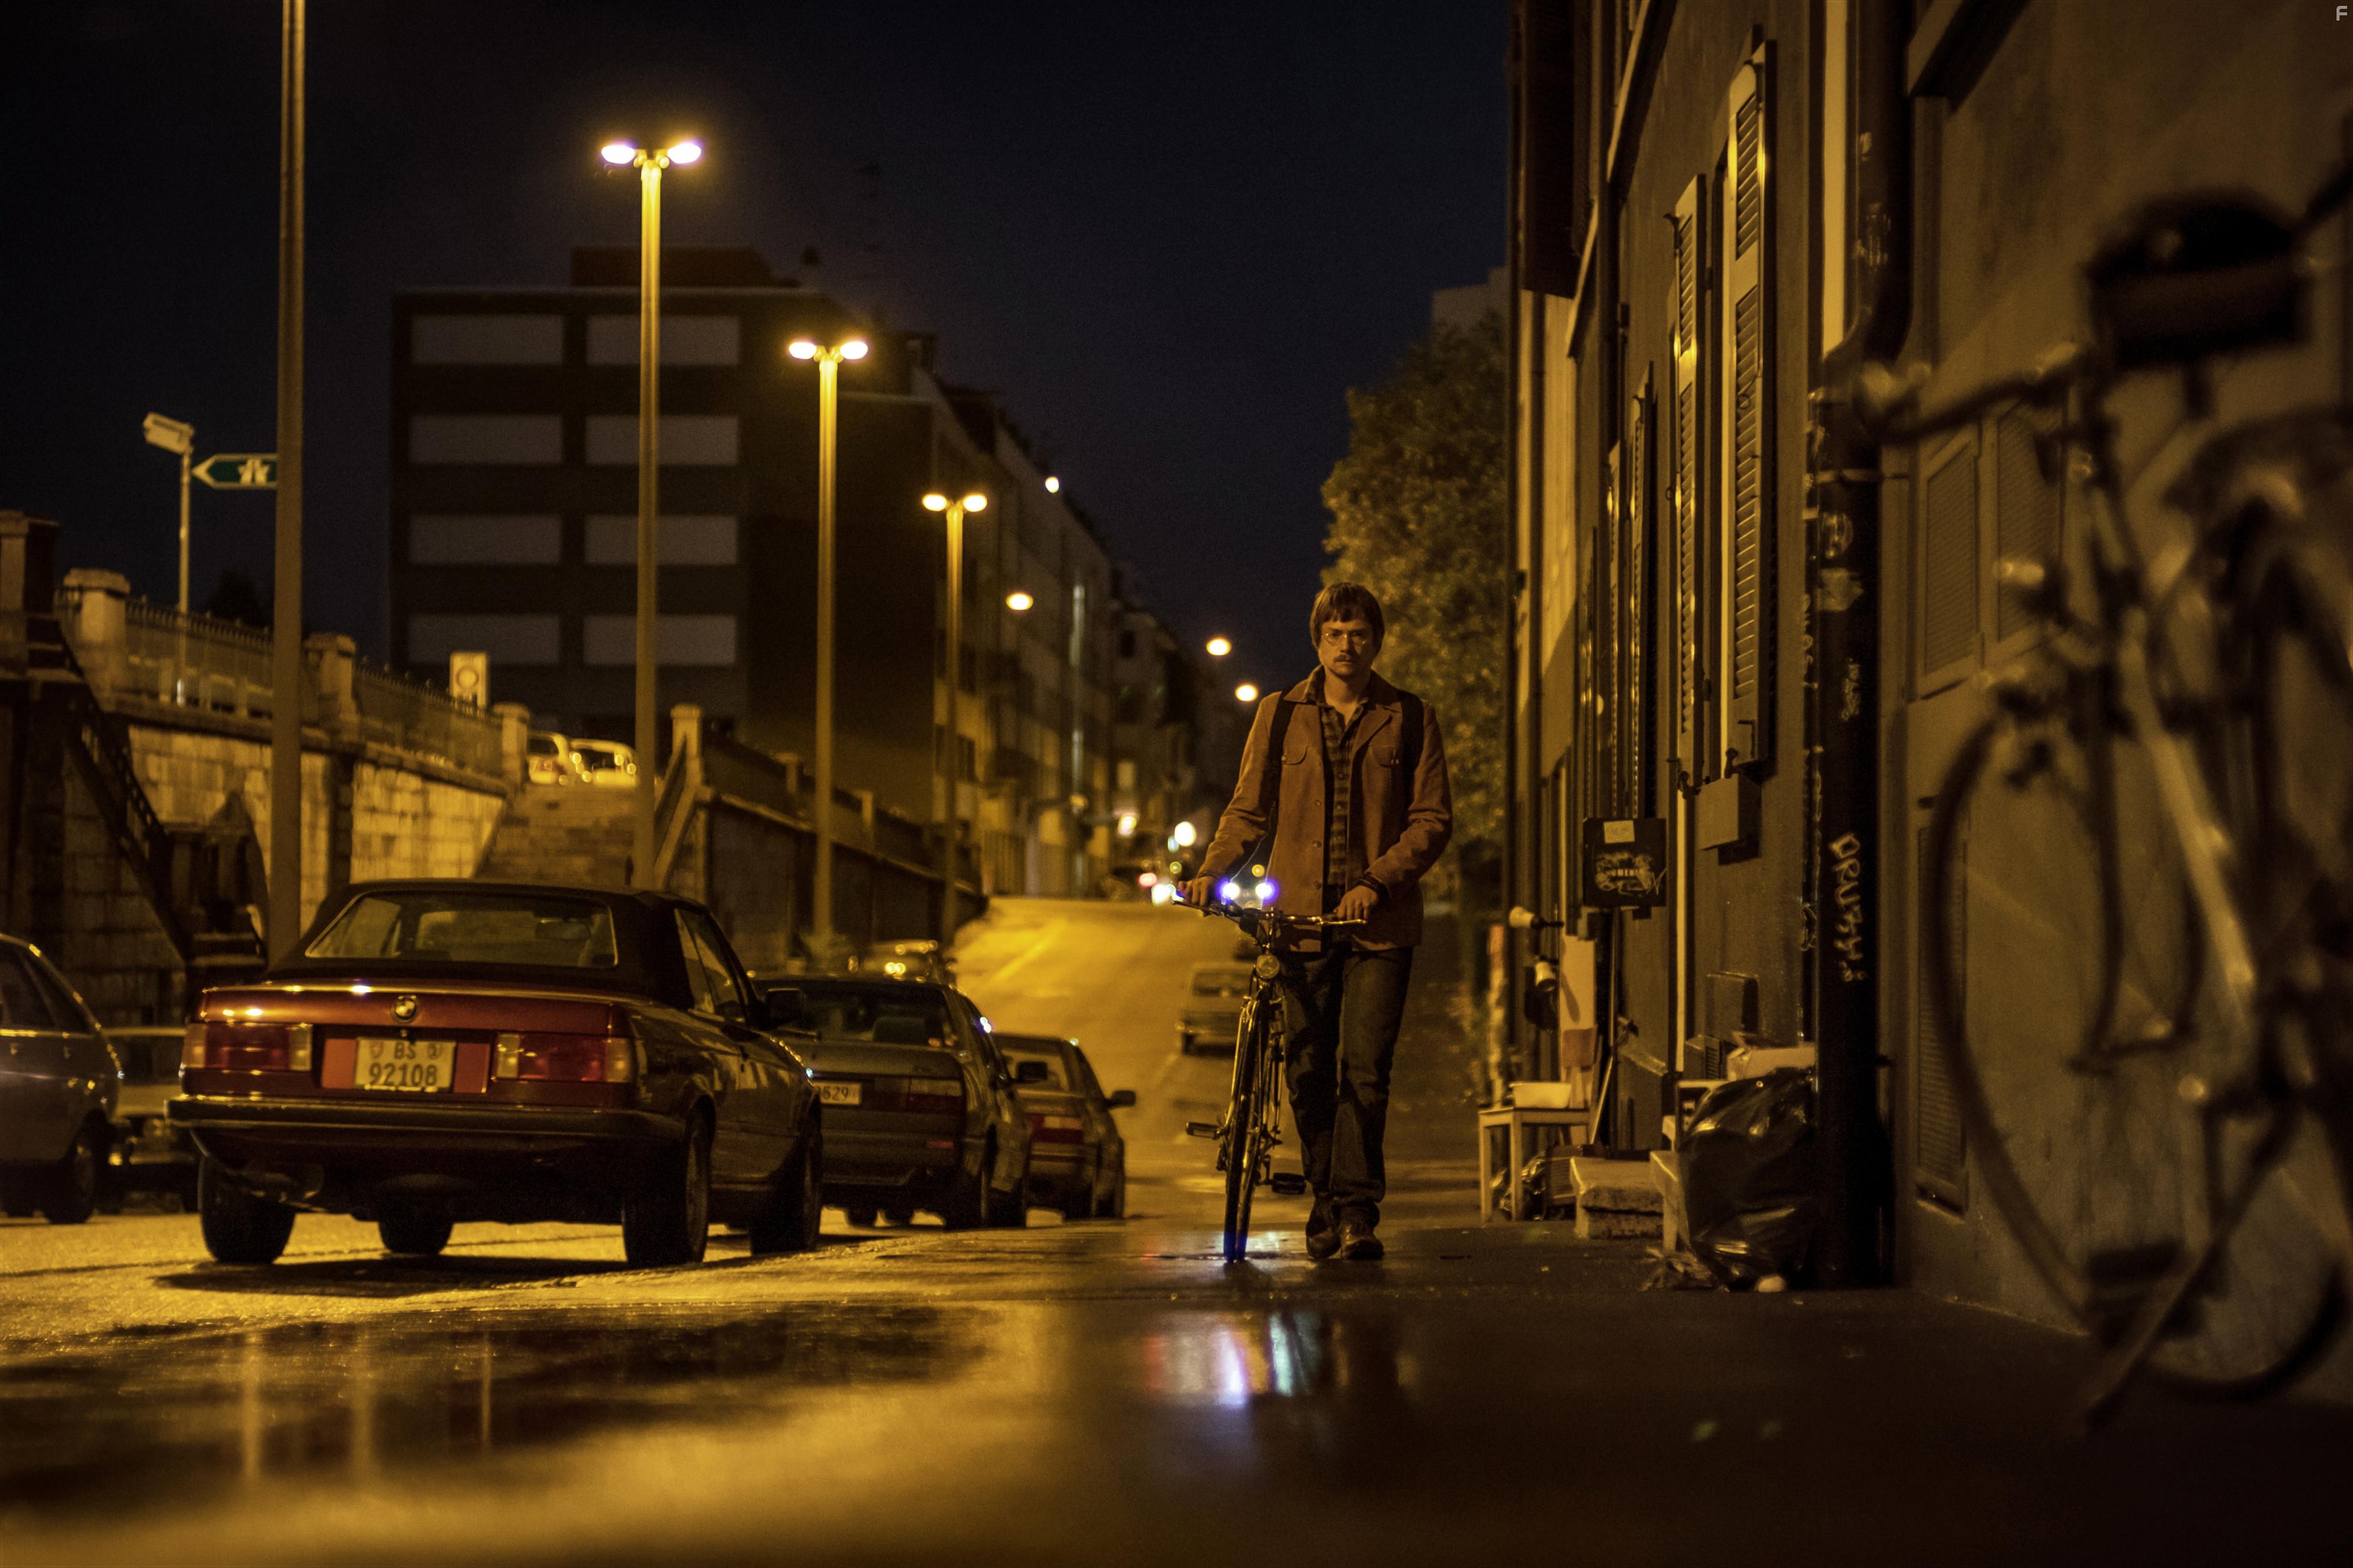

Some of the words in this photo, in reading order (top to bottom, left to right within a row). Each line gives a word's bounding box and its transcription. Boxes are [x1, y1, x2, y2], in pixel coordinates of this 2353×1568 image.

[394, 1041, 416, 1059] BS
[369, 1062, 437, 1086] 92108
[818, 1086, 849, 1101] 529
